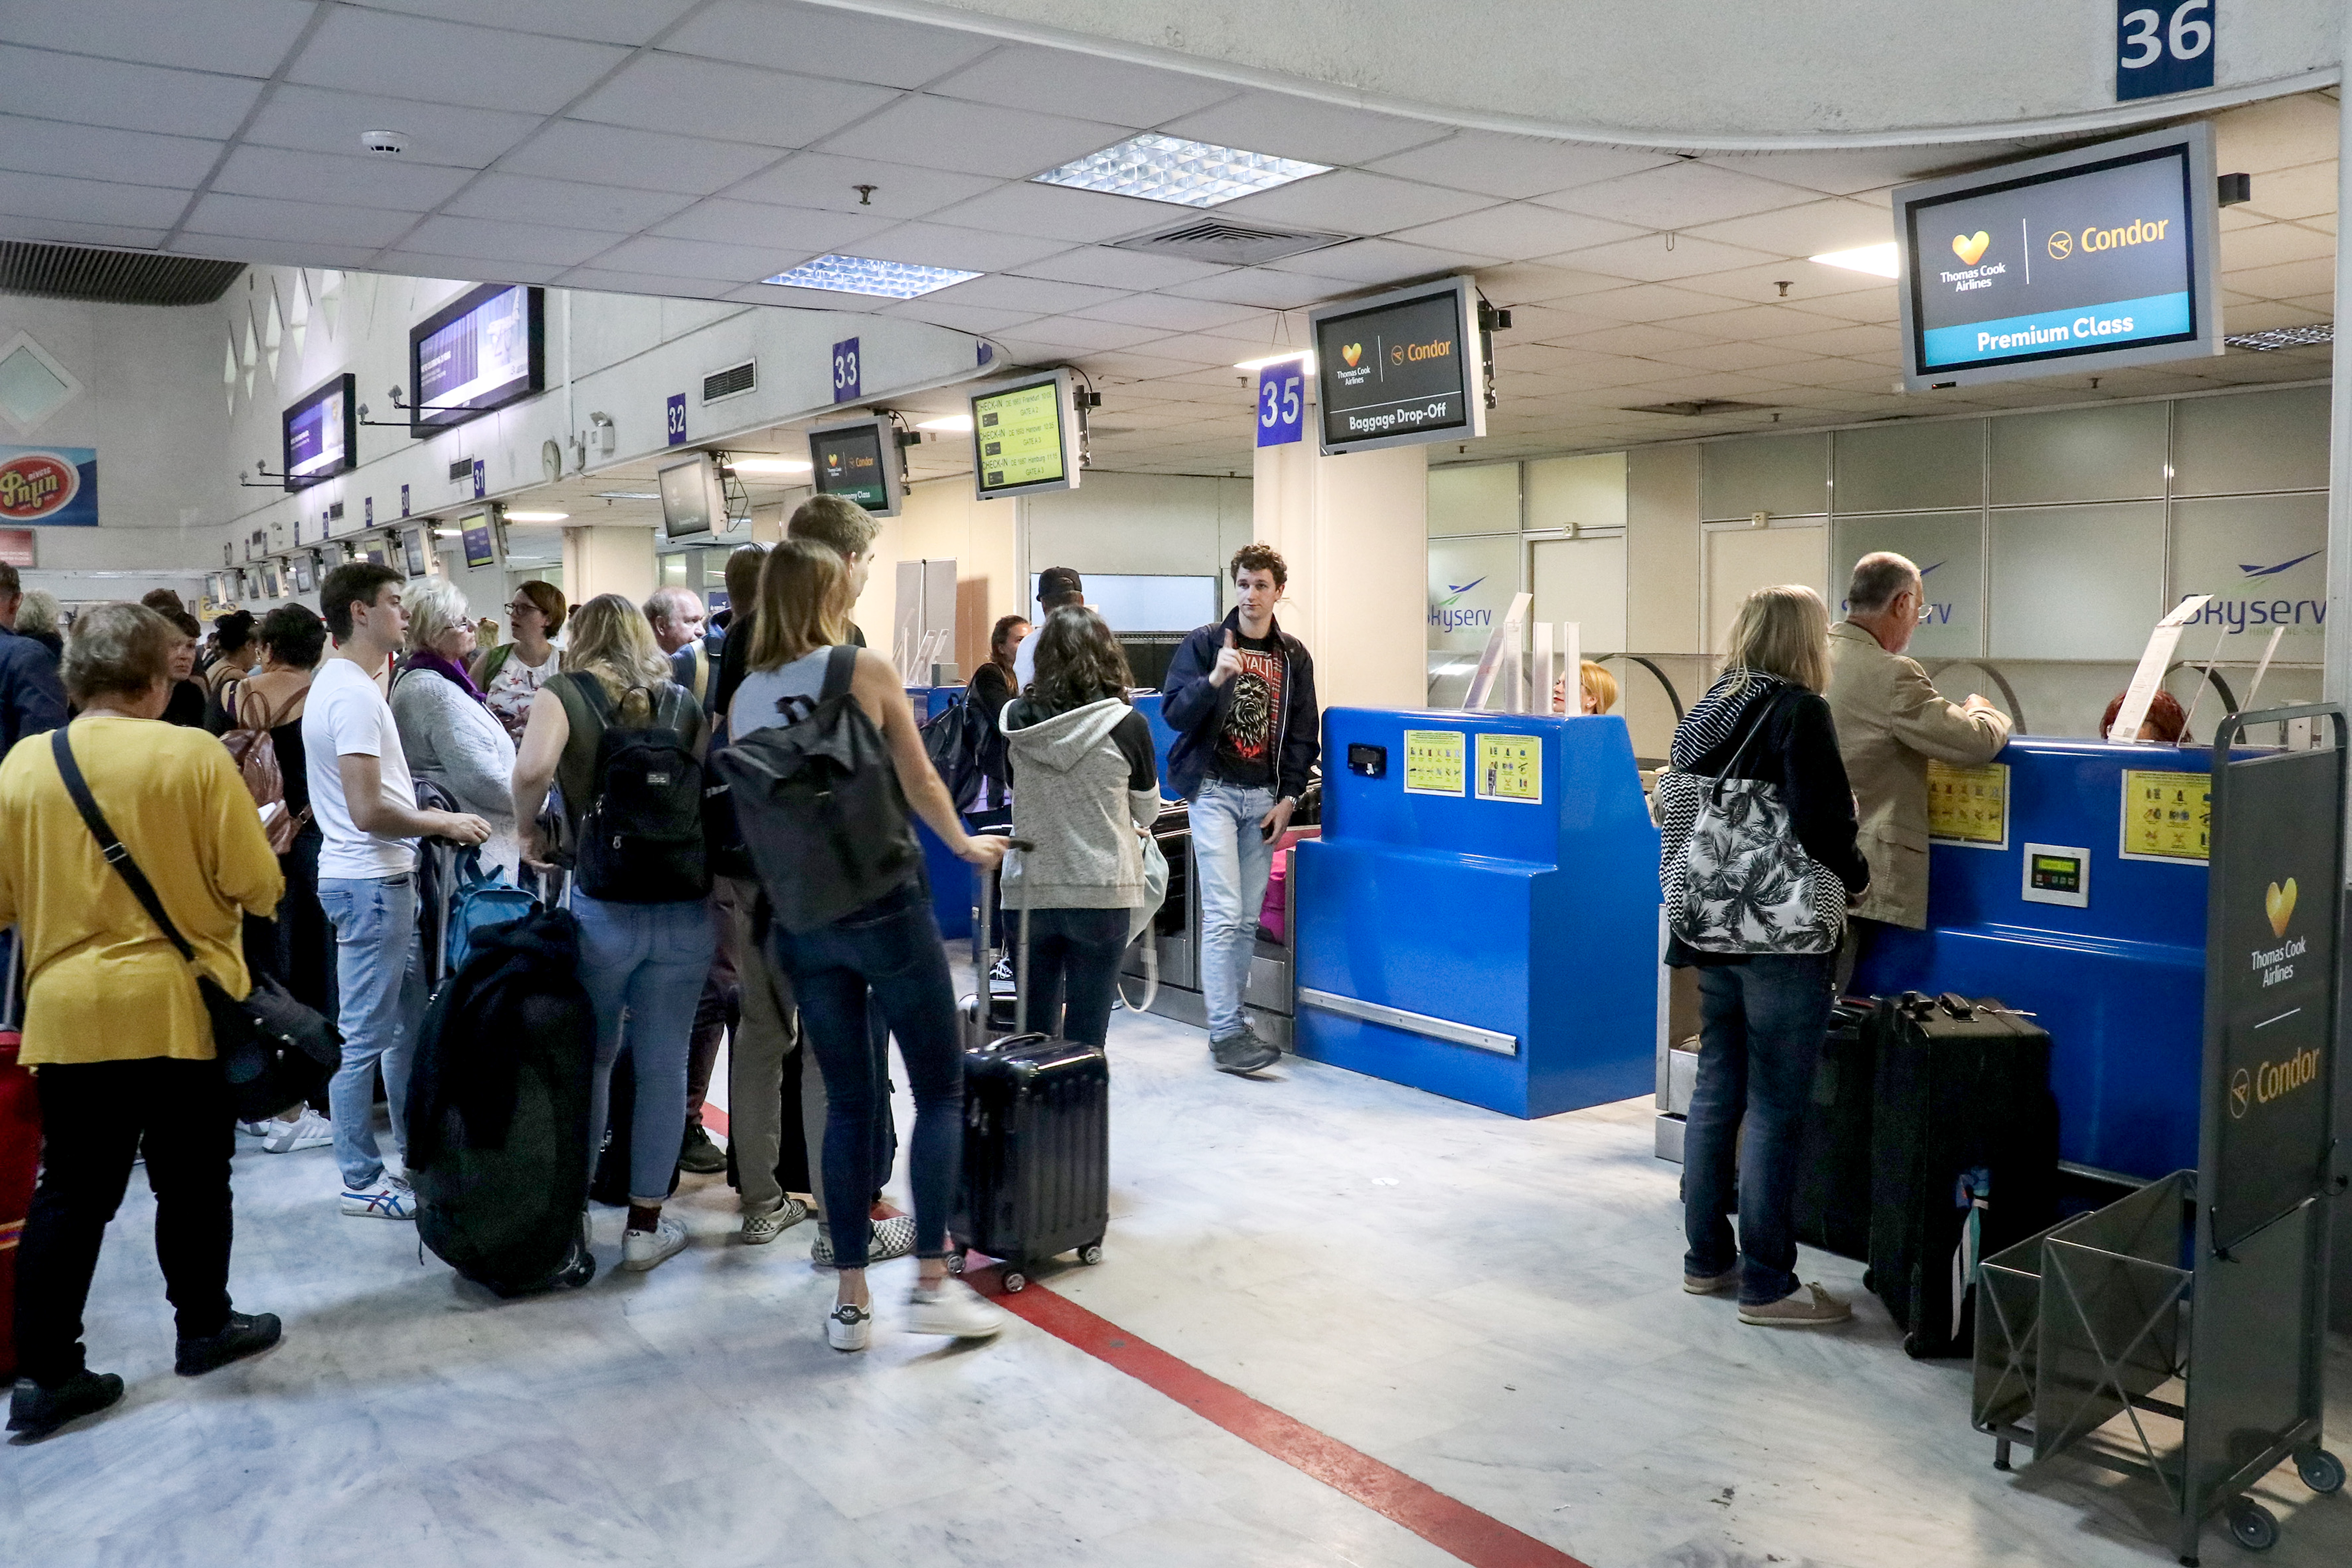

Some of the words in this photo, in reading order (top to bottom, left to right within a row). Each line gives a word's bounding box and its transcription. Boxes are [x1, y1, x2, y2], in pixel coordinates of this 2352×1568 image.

[2121, 0, 2211, 69] 36
[2081, 219, 2168, 253] Condor
[1940, 269, 1978, 283] Thomas
[1980, 262, 2006, 276] Cook
[1956, 278, 1992, 292] Airlines
[1978, 325, 2069, 351] Premium
[2073, 316, 2134, 338] Class
[1408, 340, 1451, 361] Condor
[835, 352, 856, 389] 33
[1337, 369, 1357, 379] Thomas
[1358, 366, 1370, 375] Cook
[1345, 377, 1364, 385] Airlines
[977, 399, 1002, 413] CHECK-IN
[1261, 377, 1299, 428] 35
[670, 405, 684, 434] 32
[1349, 413, 1395, 432] Baggage
[1397, 402, 1446, 424] Drop-Off
[979, 428, 1005, 442] CHECK-IN
[982, 458, 1008, 470] CHECK-IN
[475, 468, 484, 490] 31
[1427, 605, 1491, 633] kyserv
[2252, 948, 2284, 970] Thomas
[2285, 936, 2306, 958] Cook
[2263, 965, 2293, 988] Airlines
[2257, 1047, 2320, 1103] Condor
